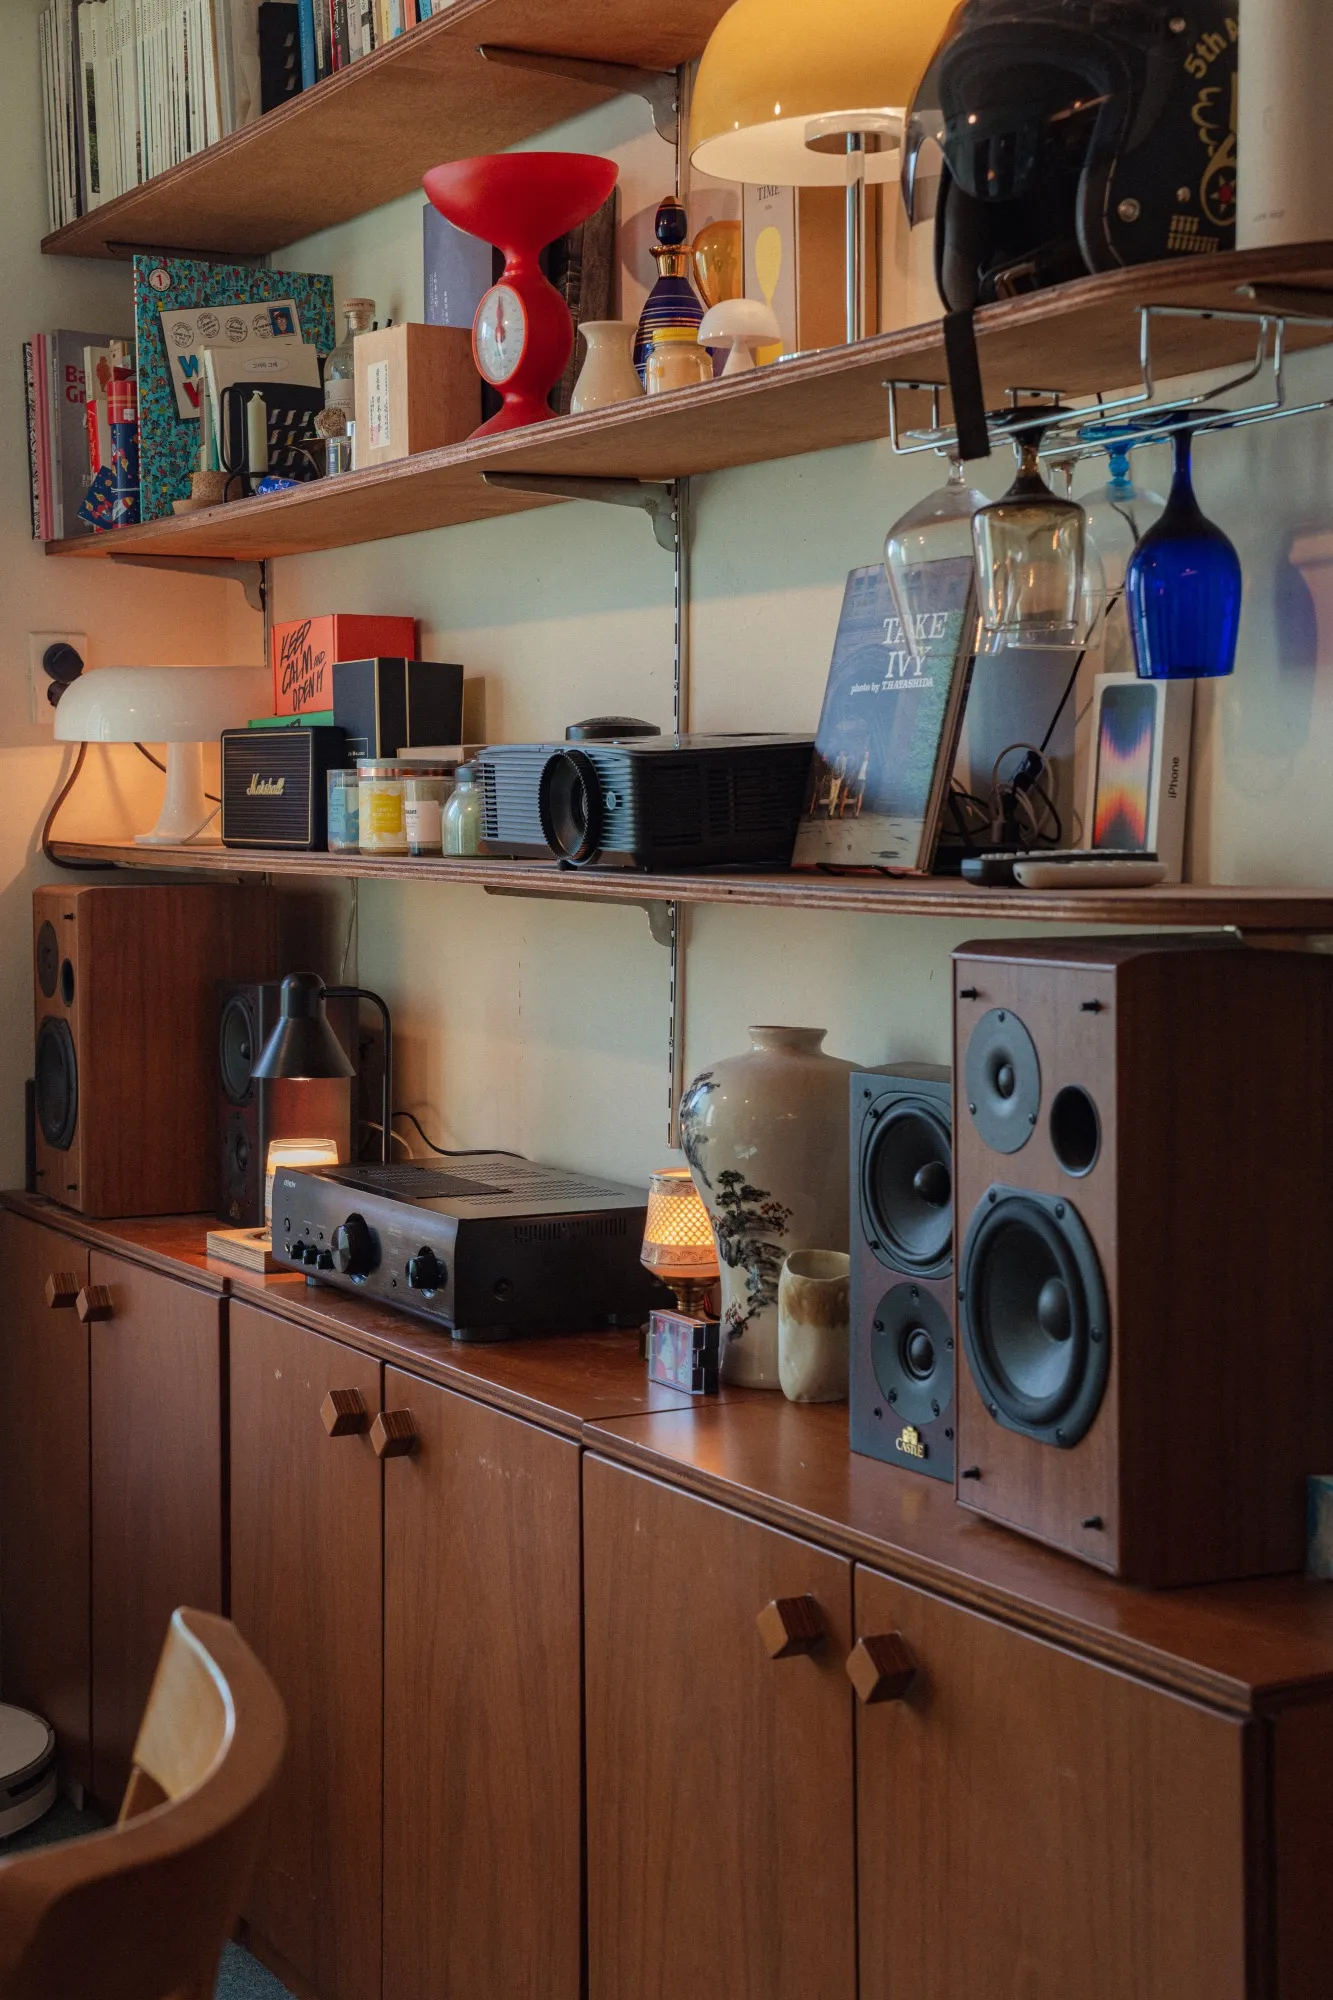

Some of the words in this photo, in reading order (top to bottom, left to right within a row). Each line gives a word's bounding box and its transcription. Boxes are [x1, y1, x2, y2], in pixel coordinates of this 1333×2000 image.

[1183, 30, 1228, 80] 5th
[757, 185, 781, 201] TIME
[155, 274, 163, 287] 1
[280, 619, 312, 668] KEEP
[882, 612, 949, 645] TAKE
[282, 643, 313, 696] CALM
[314, 650, 326, 667] AND
[884, 646, 933, 679] IVY
[293, 672, 315, 713] OPEN
[316, 661, 327, 694] IT
[850, 682, 871, 695] photo
[871, 682, 880, 694] by
[246, 772, 286, 796] Marshall
[1167, 756, 1180, 799] iPhone
[895, 1437, 924, 1459] CASTLE
